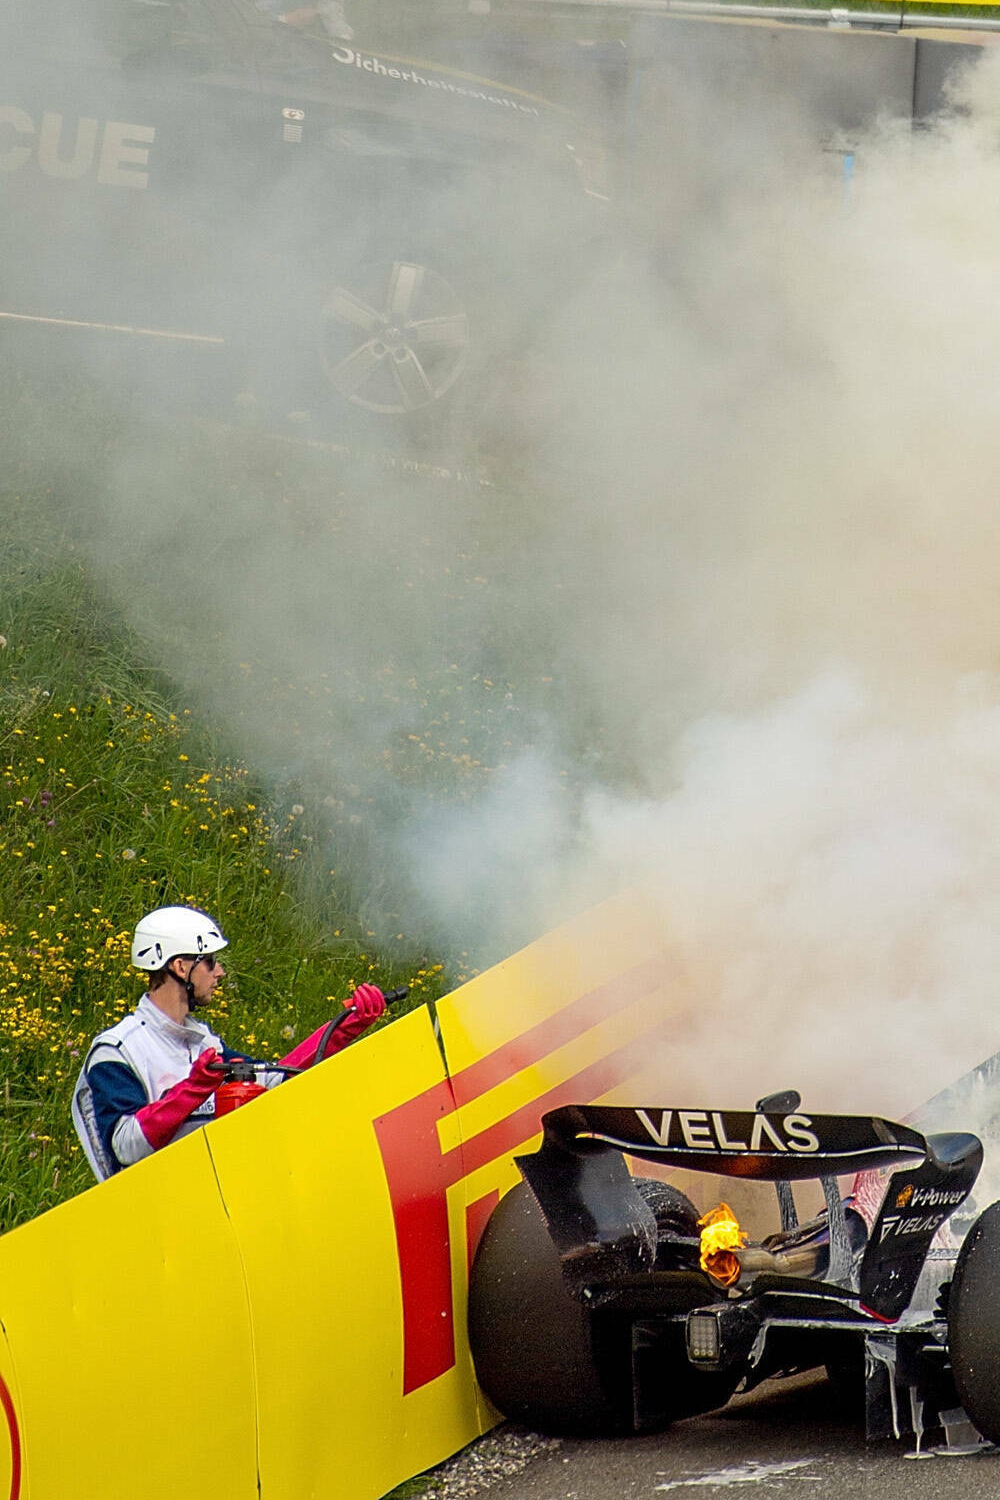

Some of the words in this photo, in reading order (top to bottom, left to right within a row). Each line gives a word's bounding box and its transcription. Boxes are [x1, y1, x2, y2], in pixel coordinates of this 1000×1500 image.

[634, 1109, 821, 1153] VELAS
[911, 1187, 967, 1208] V-Power
[894, 1214, 944, 1236] VELAS
